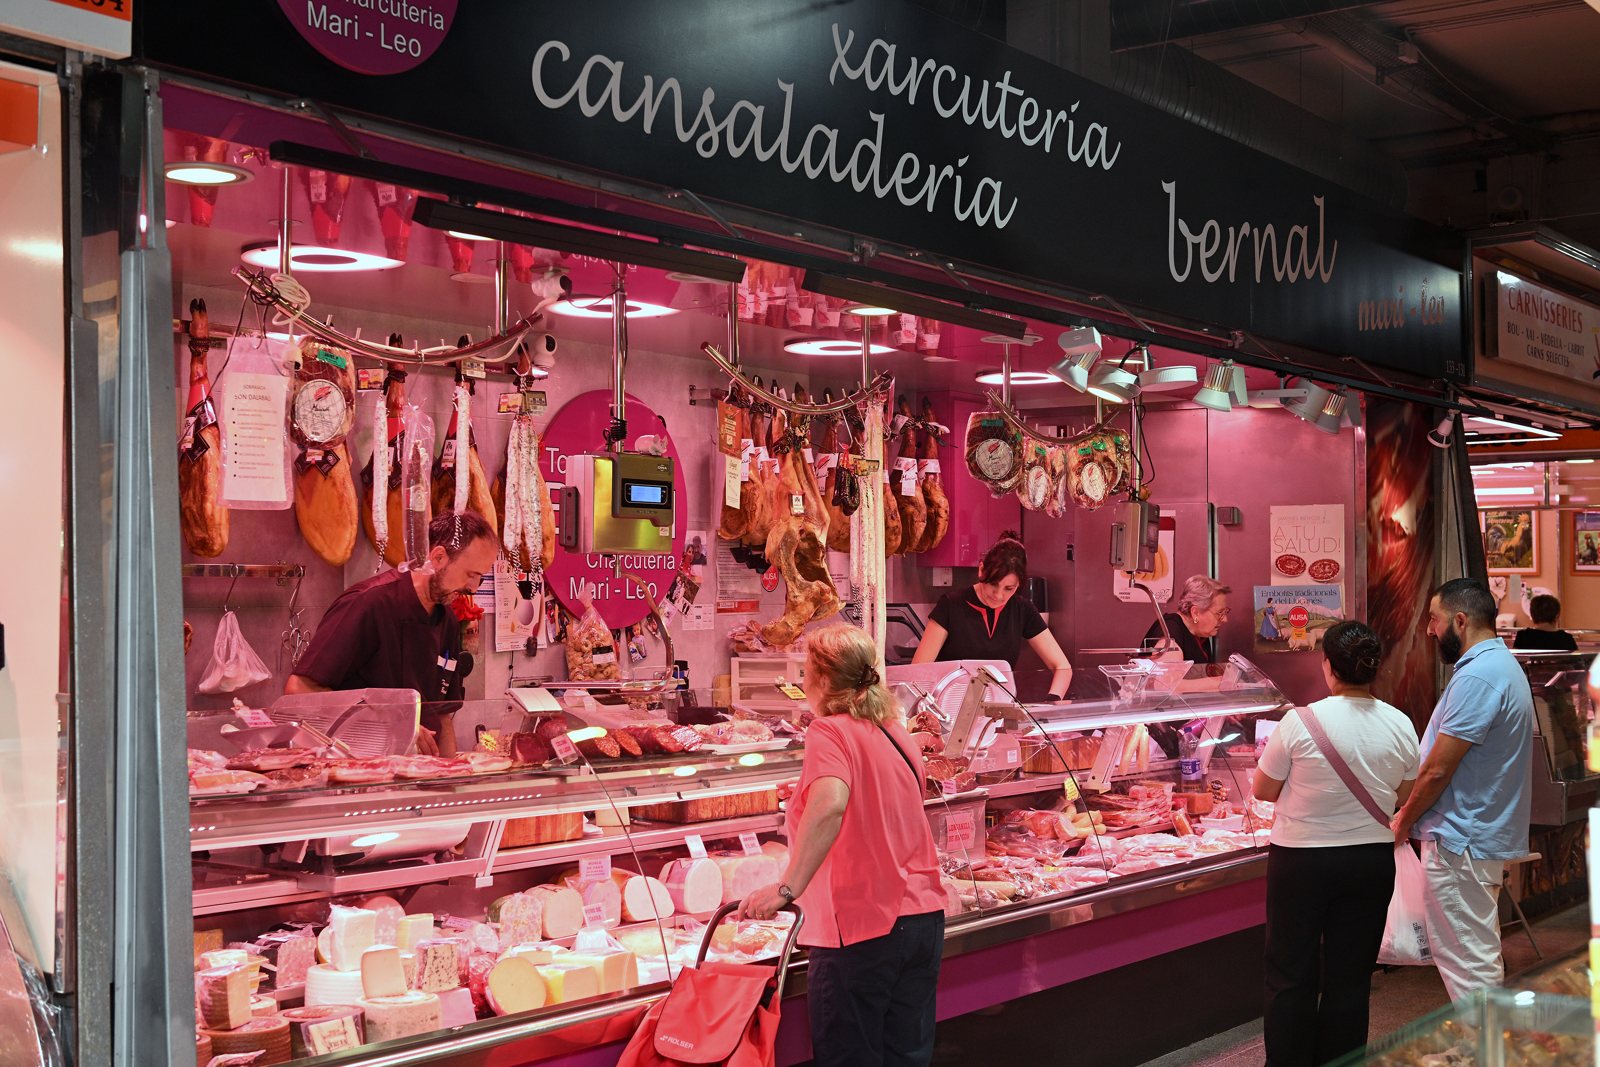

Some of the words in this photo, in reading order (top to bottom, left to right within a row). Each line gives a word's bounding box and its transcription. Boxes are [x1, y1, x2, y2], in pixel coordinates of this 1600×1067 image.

[307, 0, 359, 40] Mari
[380, 22, 422, 57] Leo
[1161, 180, 1338, 283] bernal
[1508, 287, 1583, 334] CARNISSERIES
[1273, 536, 1341, 553] SALUD!
[667, 1036, 694, 1050] ROLSER
